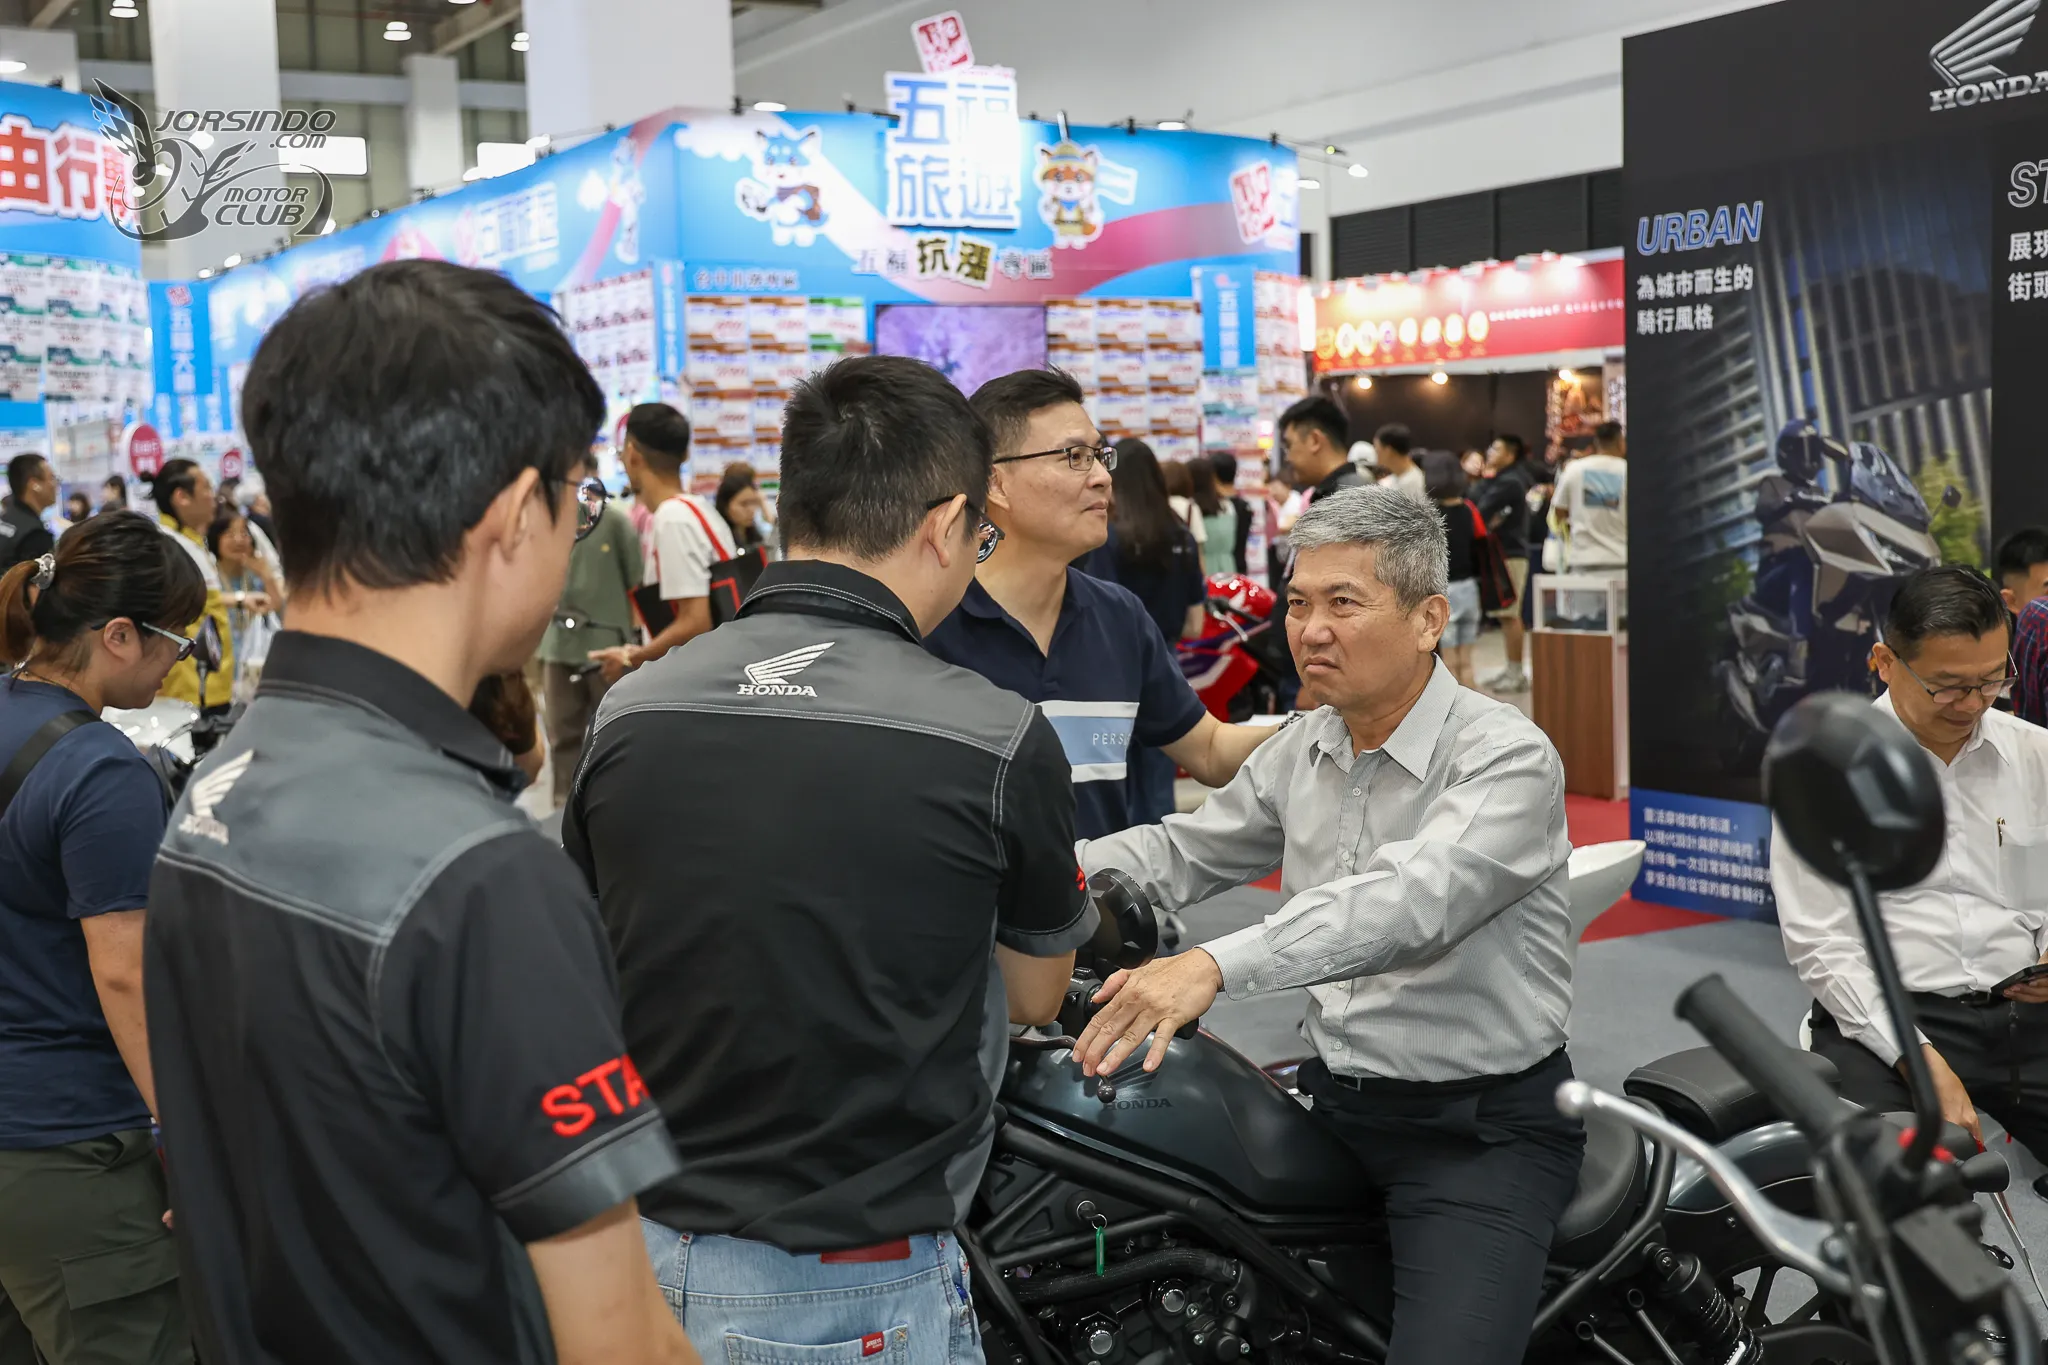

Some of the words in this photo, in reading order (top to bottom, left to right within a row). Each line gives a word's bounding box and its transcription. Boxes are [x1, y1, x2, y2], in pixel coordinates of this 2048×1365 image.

[1929, 70, 2048, 112] HONDA
[1636, 200, 1764, 256] URBAN
[1636, 263, 1754, 301] 為城市而生的
[1636, 303, 1714, 335] 騎行風格
[737, 683, 818, 698] HONDA
[1102, 1097, 1174, 1112] HONDA
